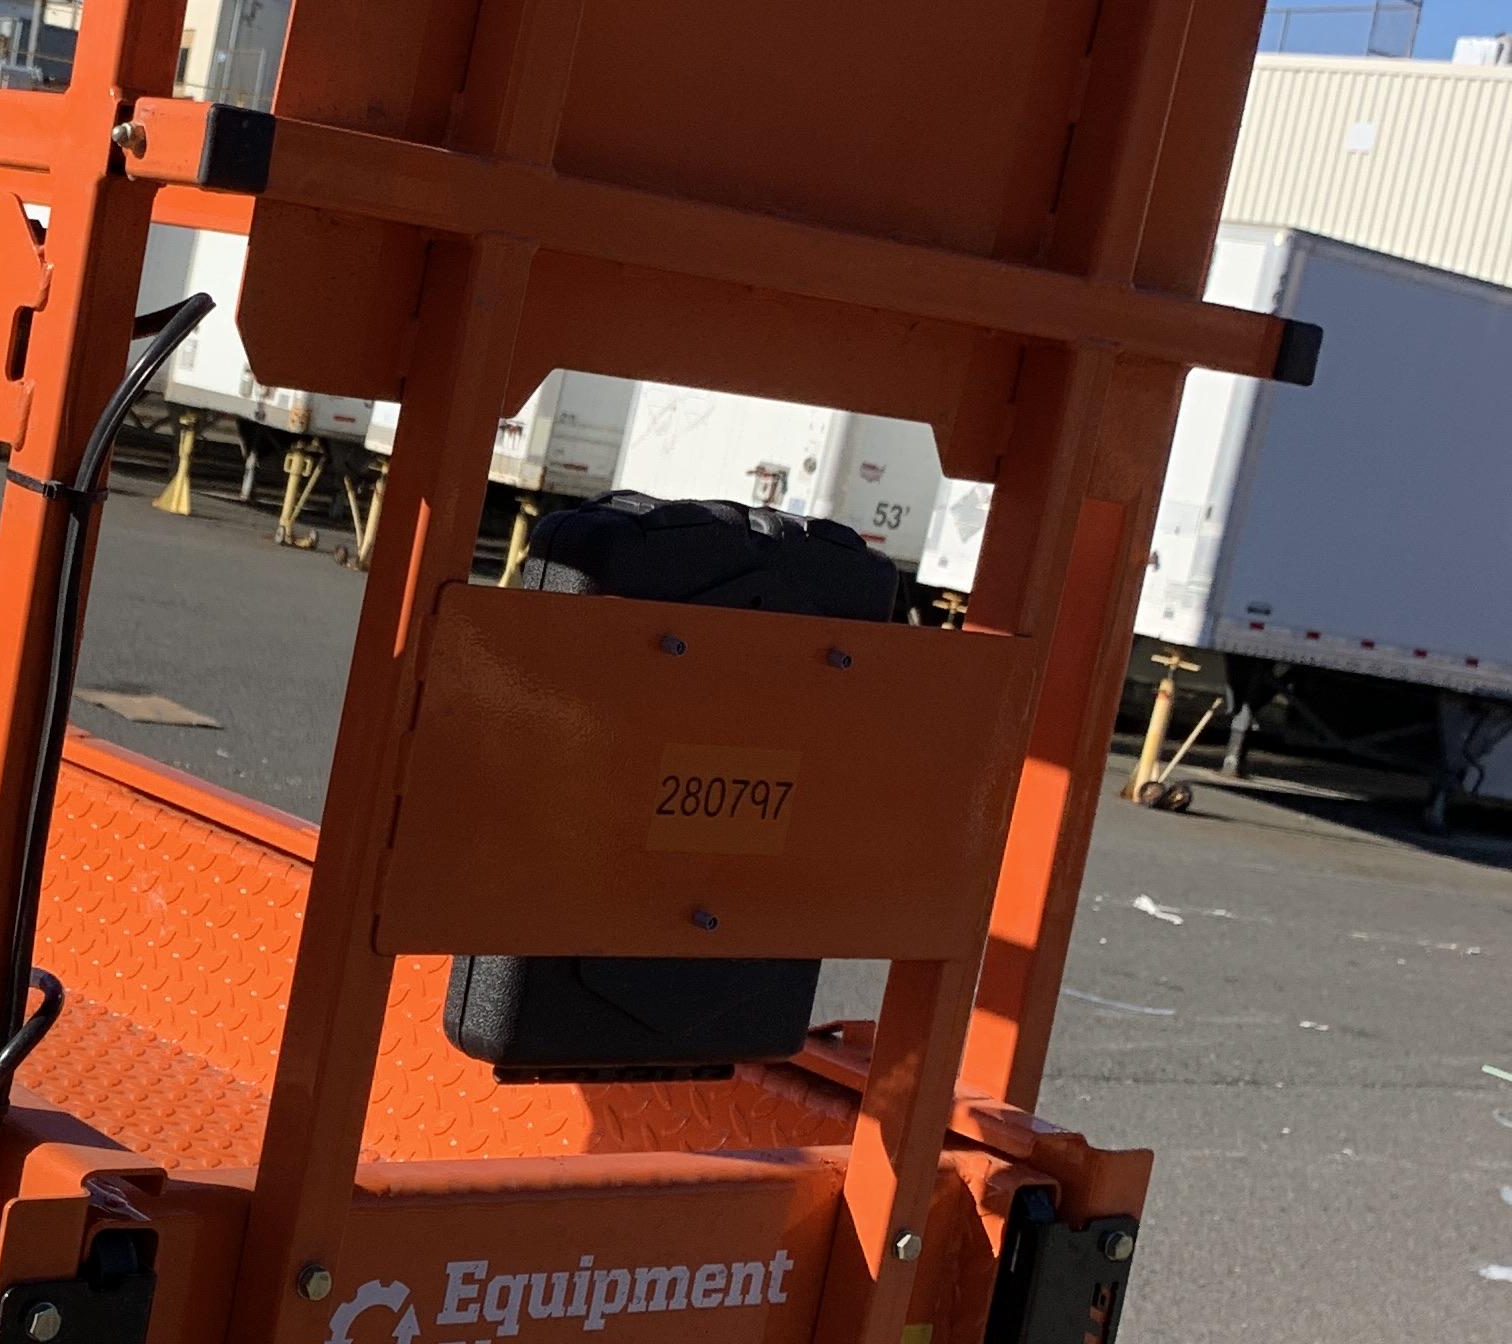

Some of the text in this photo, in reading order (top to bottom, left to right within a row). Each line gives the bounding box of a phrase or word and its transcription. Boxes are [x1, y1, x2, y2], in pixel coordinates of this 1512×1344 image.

[872, 501, 910, 530] 53'
[655, 775, 794, 820] 280797
[436, 1249, 794, 1337] Equipment
